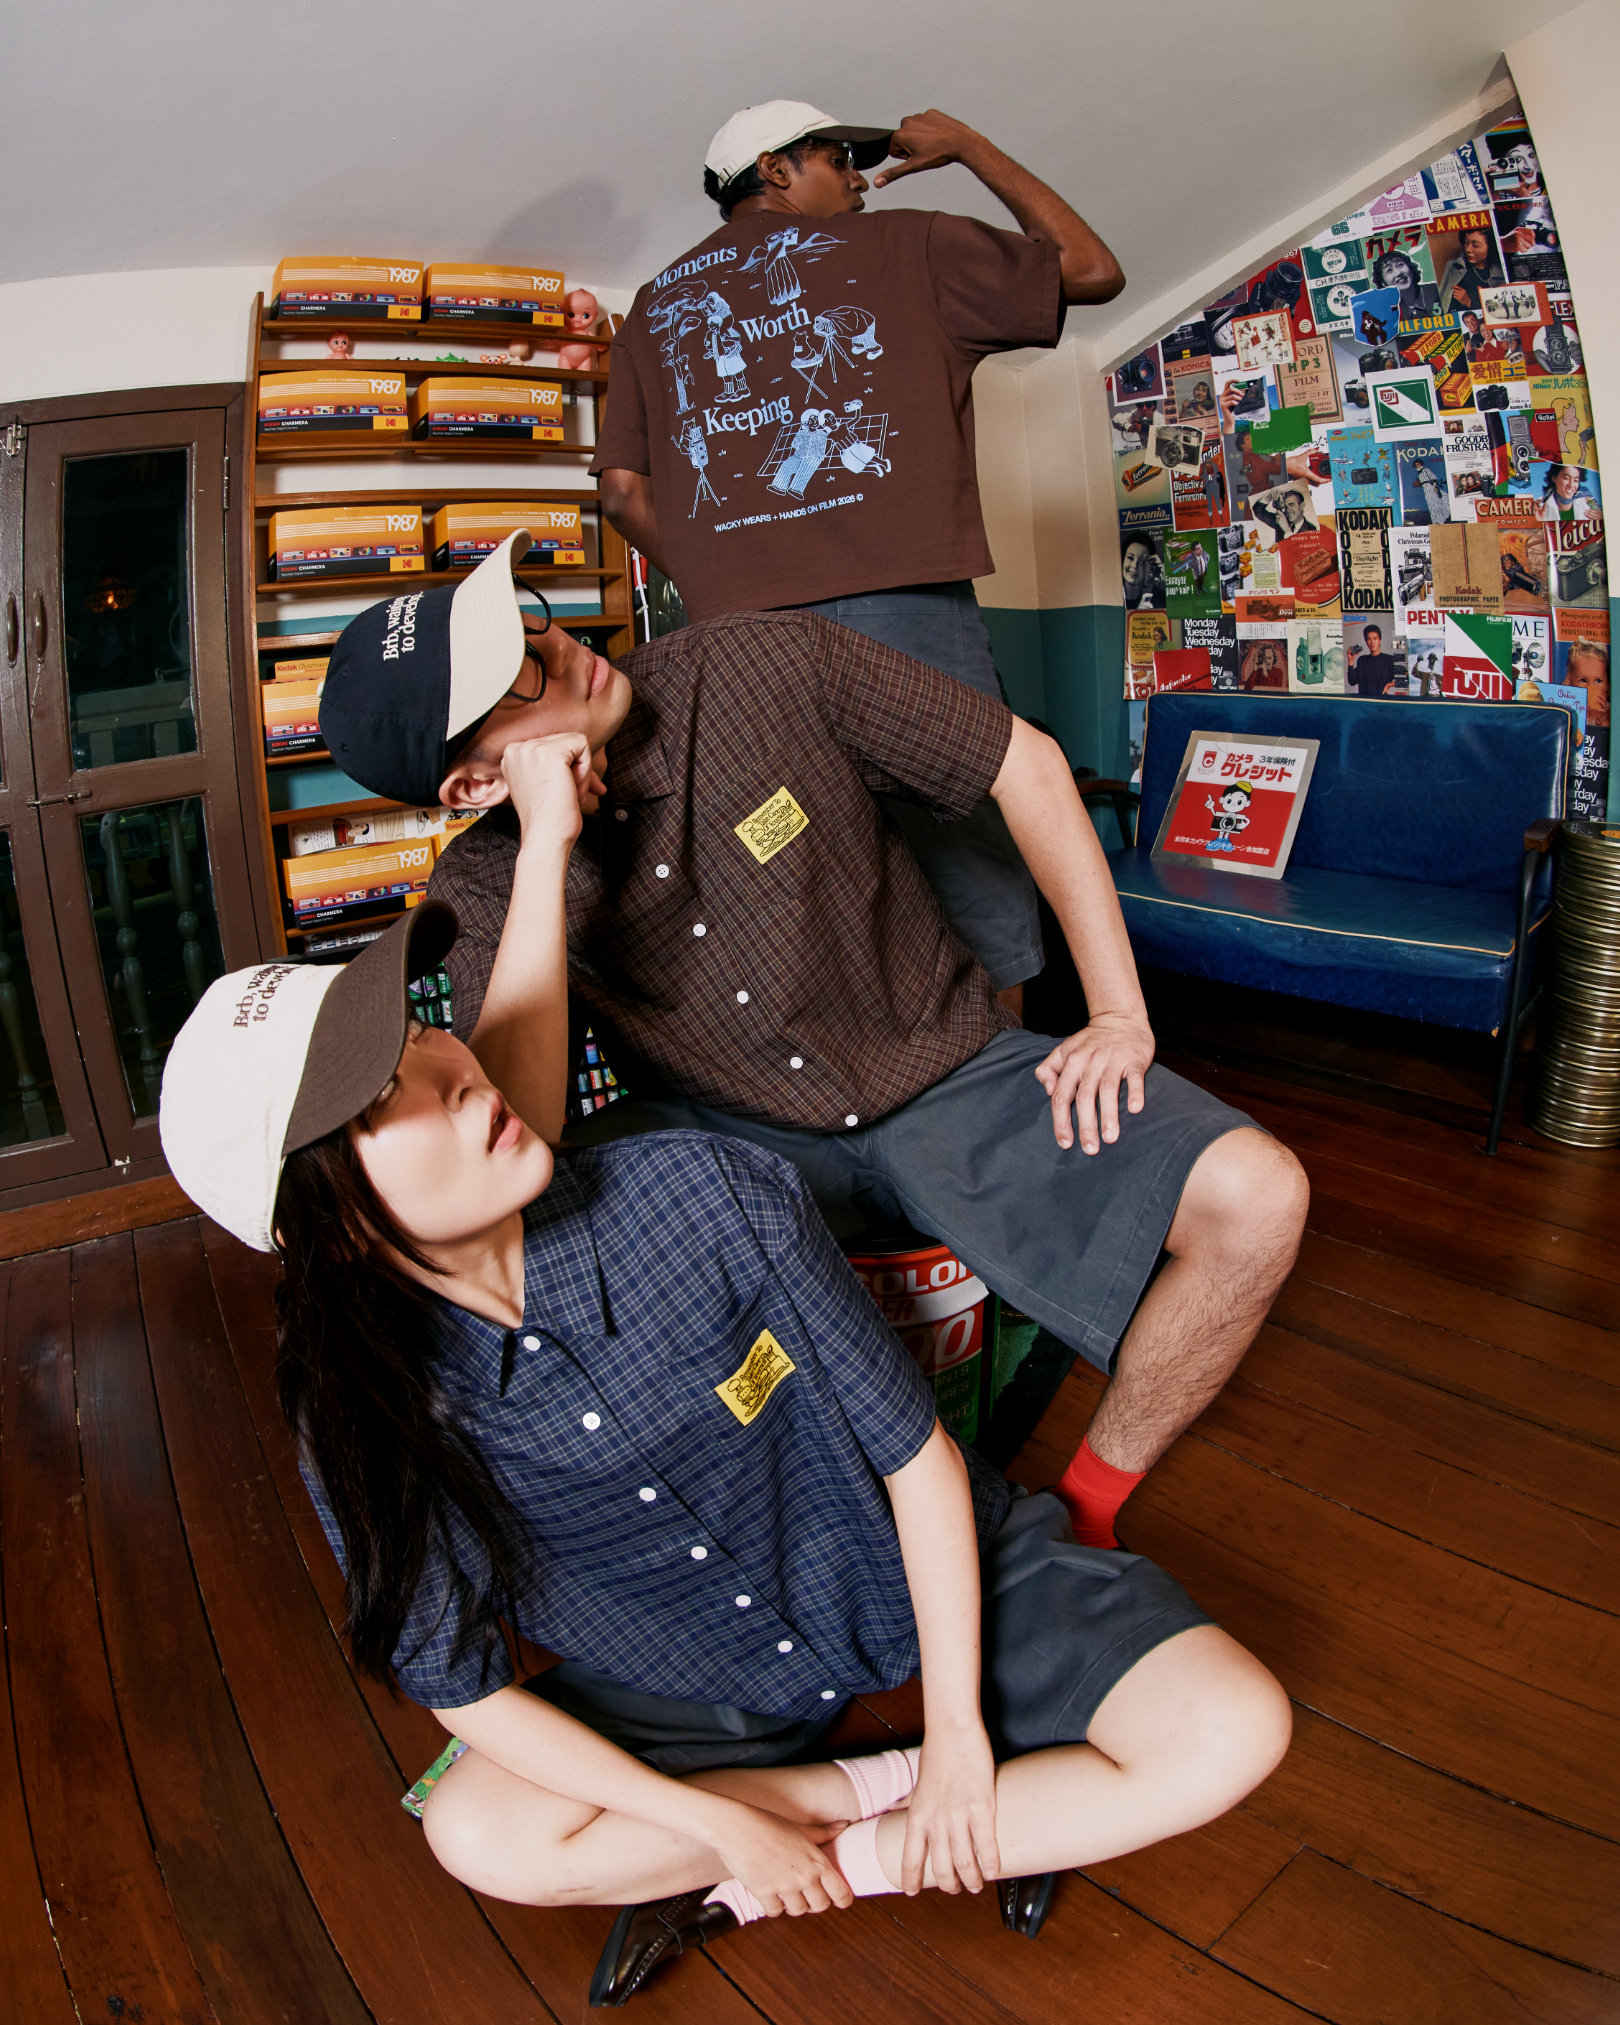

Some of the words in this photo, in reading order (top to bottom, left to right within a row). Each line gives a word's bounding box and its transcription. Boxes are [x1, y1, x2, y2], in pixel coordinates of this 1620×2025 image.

[1426, 212, 1489, 233] CAMERA
[388, 267, 420, 283] 1987
[652, 247, 737, 293] Moments
[531, 276, 561, 292] 1987
[1432, 302, 1442, 316] 5
[739, 301, 811, 342] Worth
[1399, 314, 1454, 333] ILFORD
[1420, 333, 1442, 356] ILFORD
[1180, 361, 1211, 372] KONICA
[369, 379, 401, 394] 1987
[1294, 375, 1319, 386] FILM
[529, 389, 558, 405] 1987
[703, 396, 793, 435] Keeping
[385, 514, 418, 532] 1987
[548, 512, 577, 527] 1987
[714, 519, 741, 533] WACKY
[742, 514, 771, 525] WEARS
[779, 508, 806, 520] HANDS
[807, 505, 818, 514] ON
[819, 499, 837, 511] FILM
[1338, 510, 1390, 531] KODAK
[1343, 588, 1394, 609] KODAK
[1455, 586, 1482, 594] Kodak
[1184, 618, 1218, 628] Monday
[1185, 627, 1219, 638] Tuesday
[381, 630, 401, 661] Brb,
[401, 637, 415, 653] to
[1185, 636, 1235, 648] Wednesday
[277, 664, 297, 672] Kodak
[1226, 753, 1253, 763] カメラ
[1259, 756, 1296, 766] 3年保険付
[1221, 762, 1292, 782] クレジット
[397, 847, 429, 869] 1987
[233, 992, 257, 1028] Brb,
[253, 1003, 269, 1021] to
